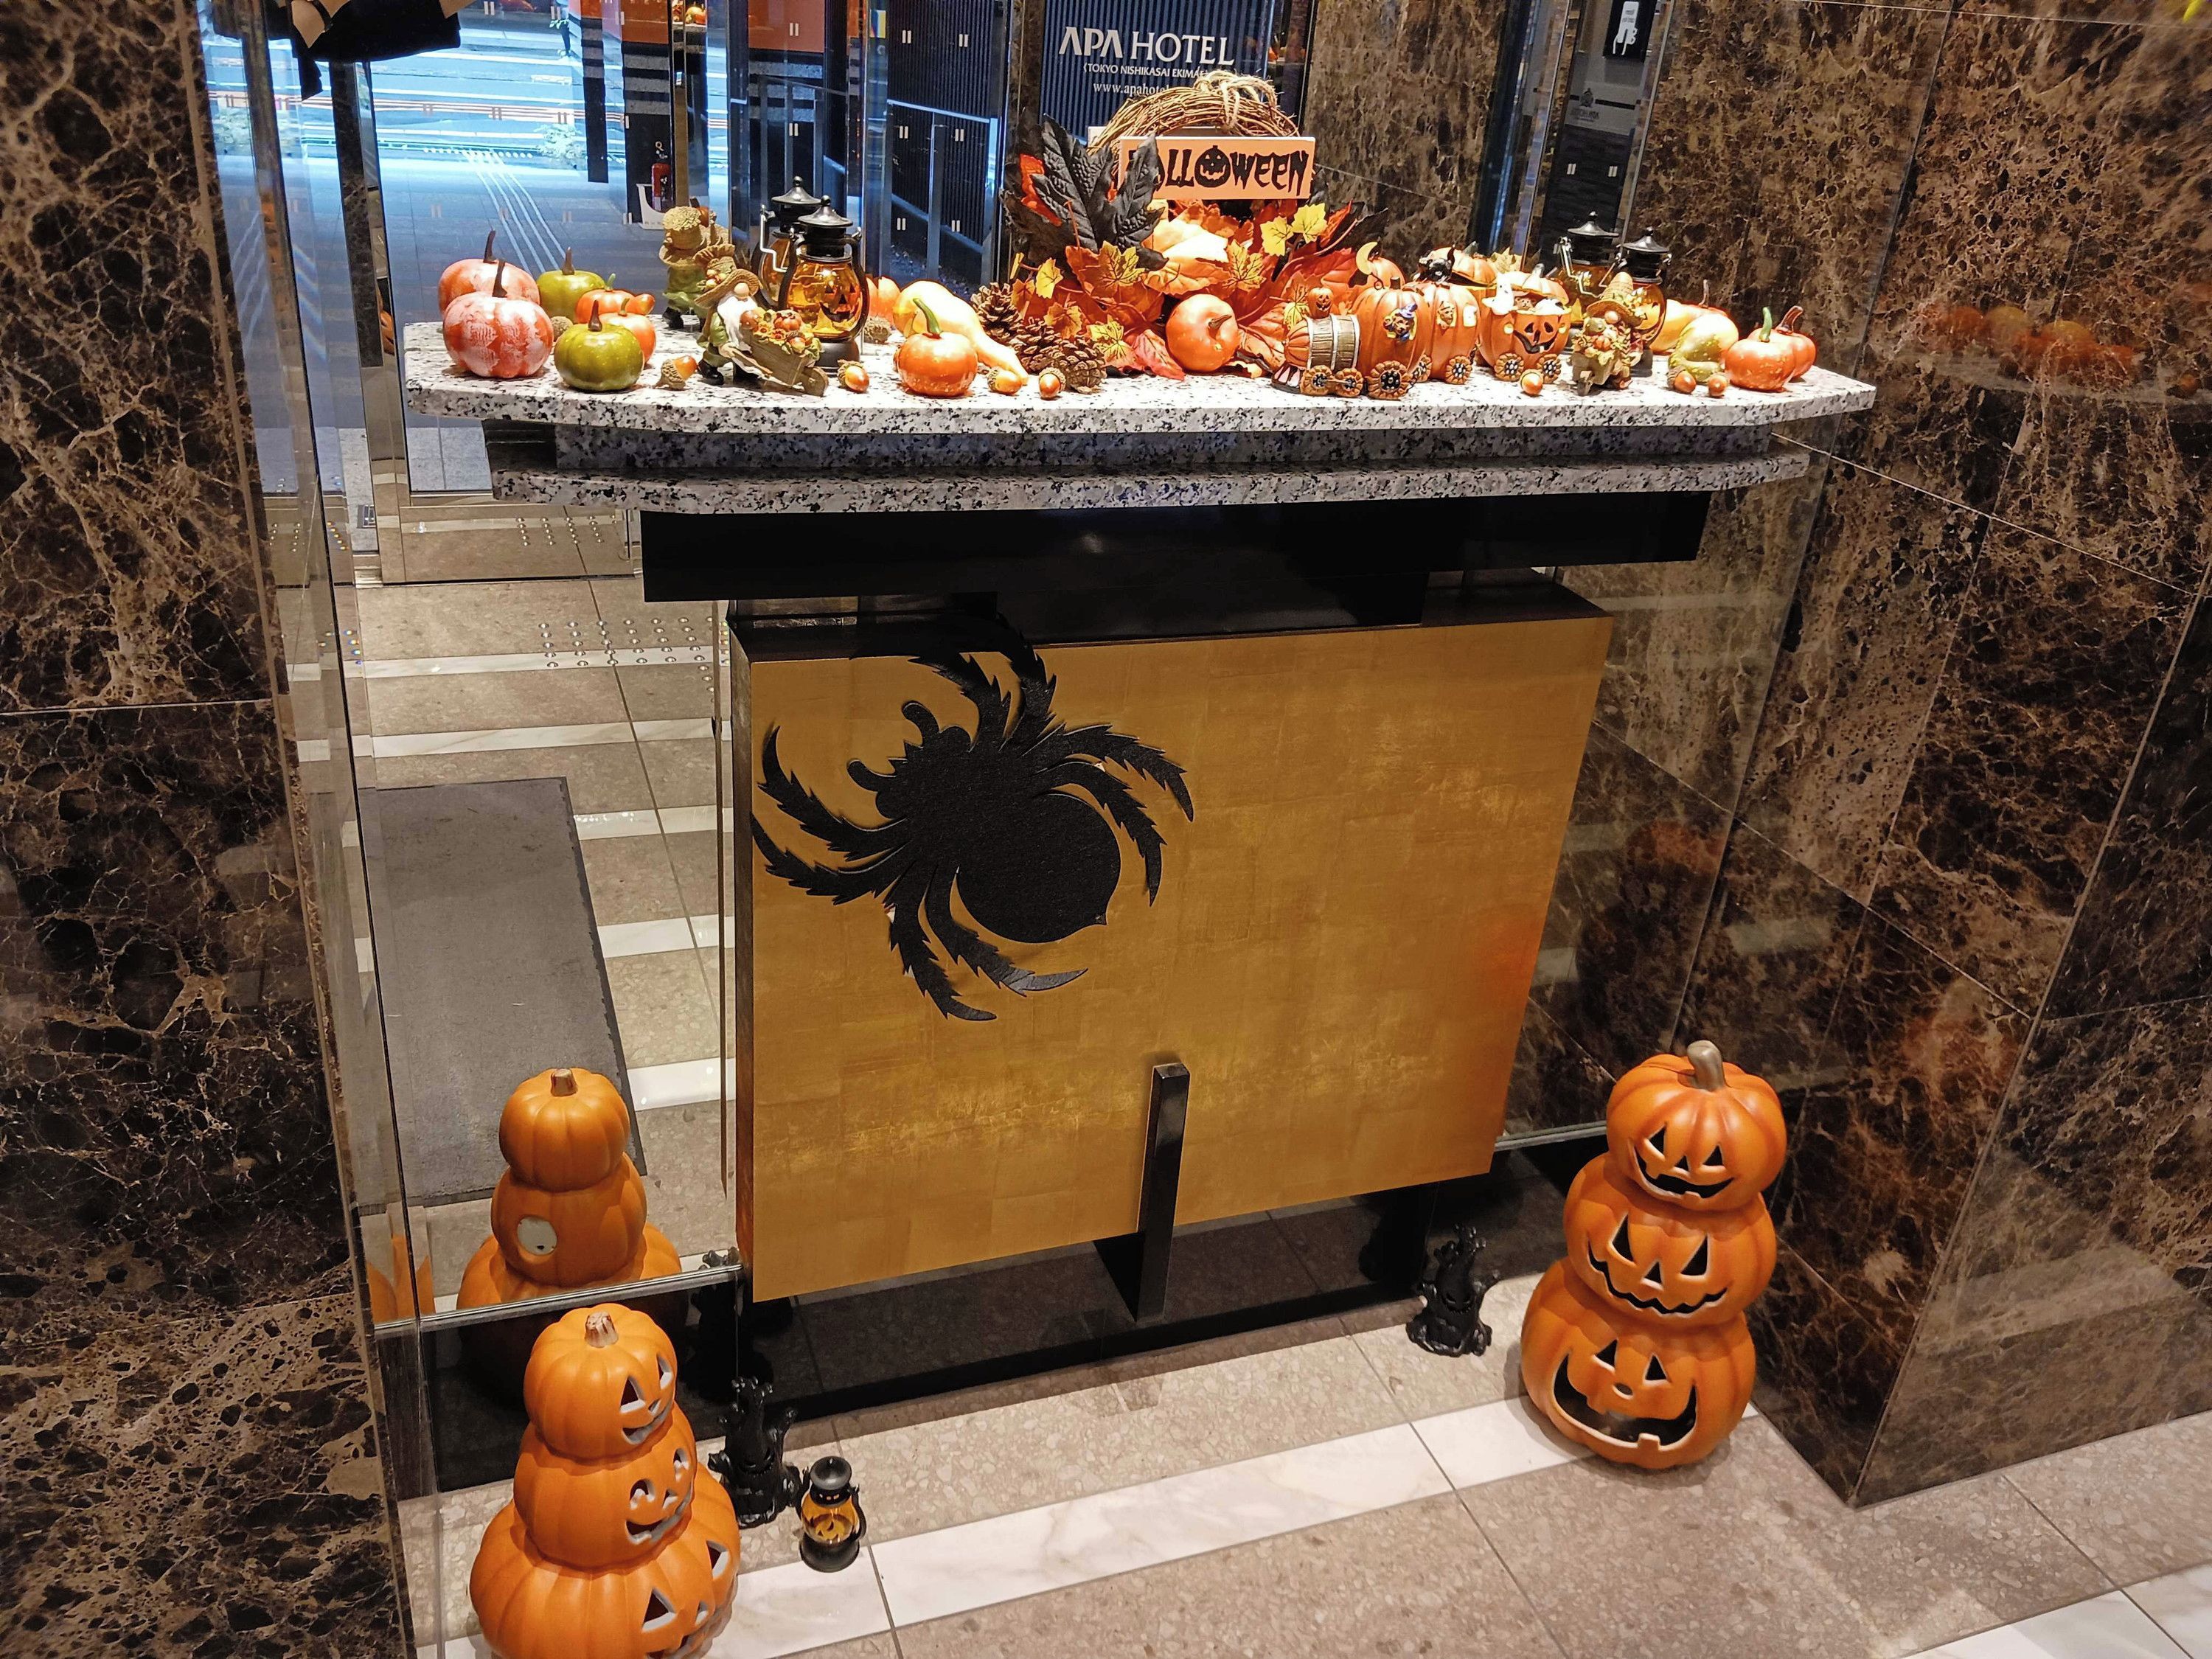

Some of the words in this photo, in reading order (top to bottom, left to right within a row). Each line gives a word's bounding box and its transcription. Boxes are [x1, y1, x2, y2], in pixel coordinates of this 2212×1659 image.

[1059, 26, 1123, 58] APA
[1130, 31, 1234, 65] HOTEL
[1120, 66, 1170, 77] NISHIKASAI
